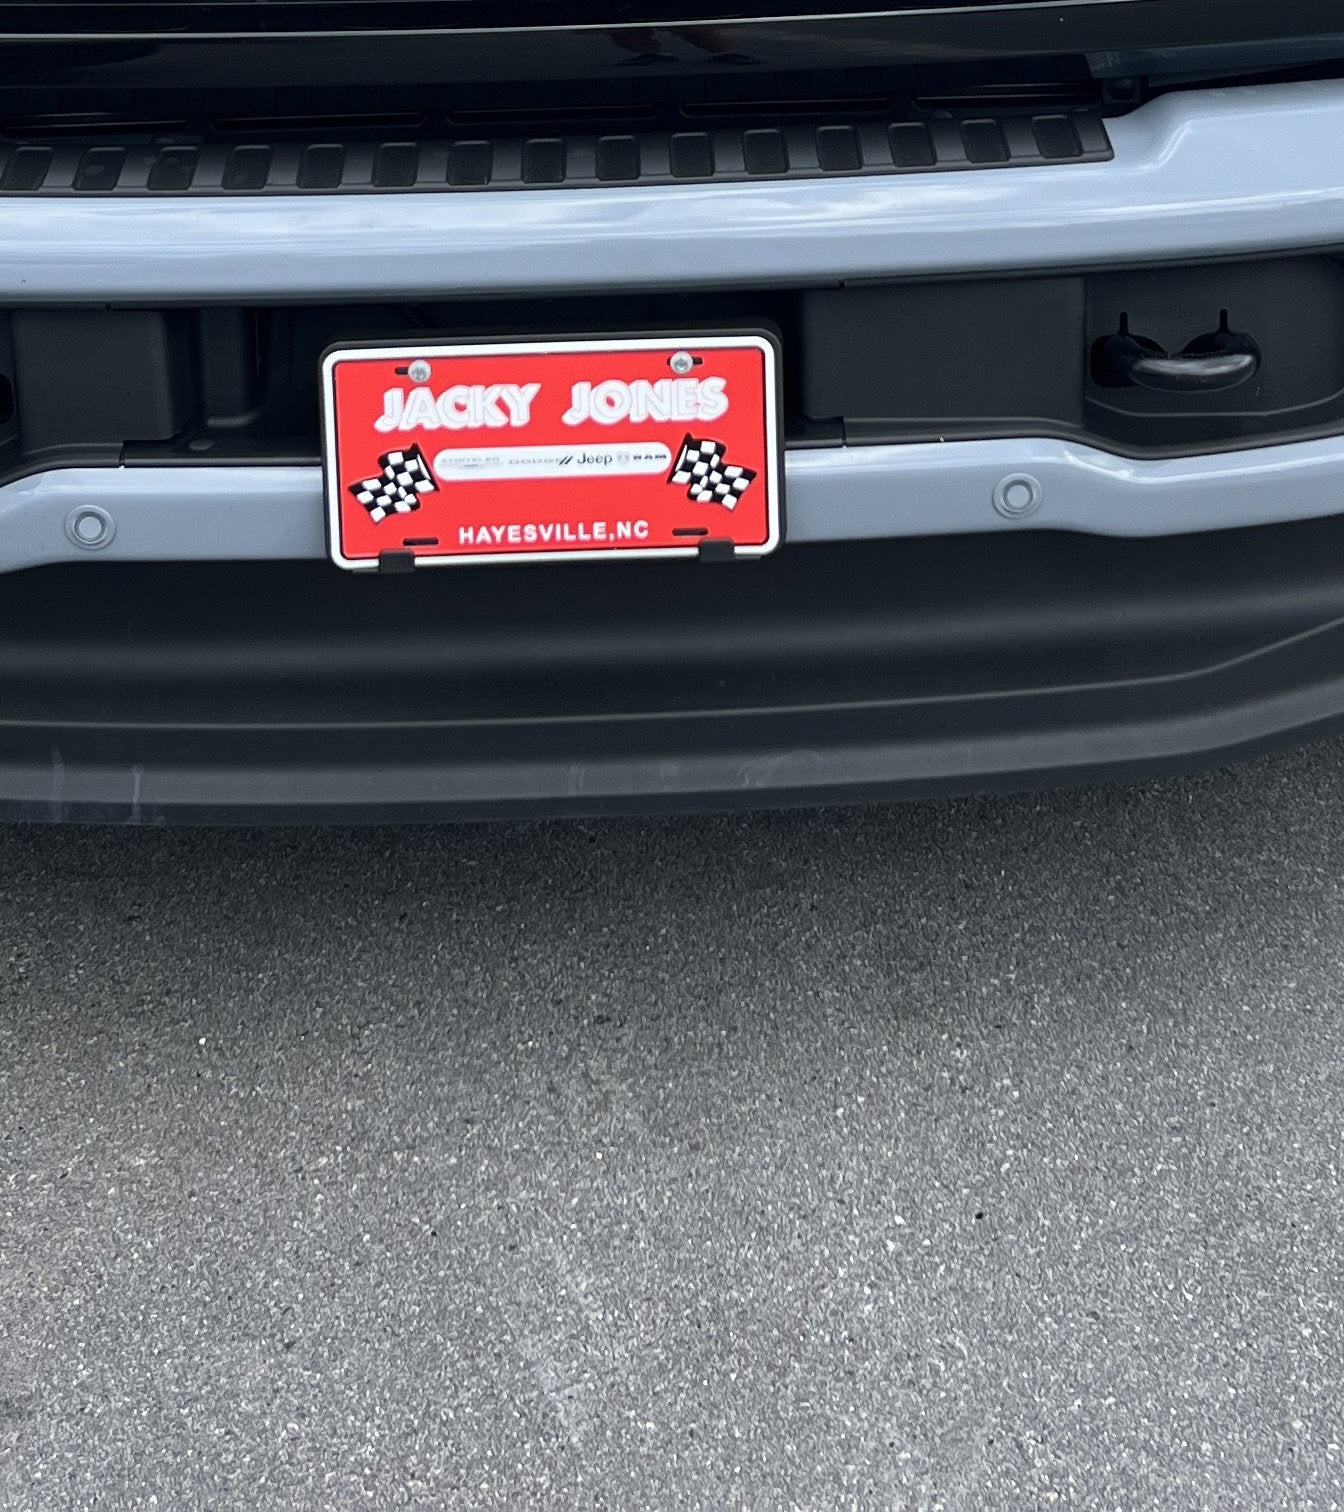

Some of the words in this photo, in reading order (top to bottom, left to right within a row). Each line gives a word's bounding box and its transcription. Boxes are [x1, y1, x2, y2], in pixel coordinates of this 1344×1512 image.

[374, 383, 541, 432] JACKY
[562, 377, 729, 427] JONES
[576, 452, 613, 466] Jeep
